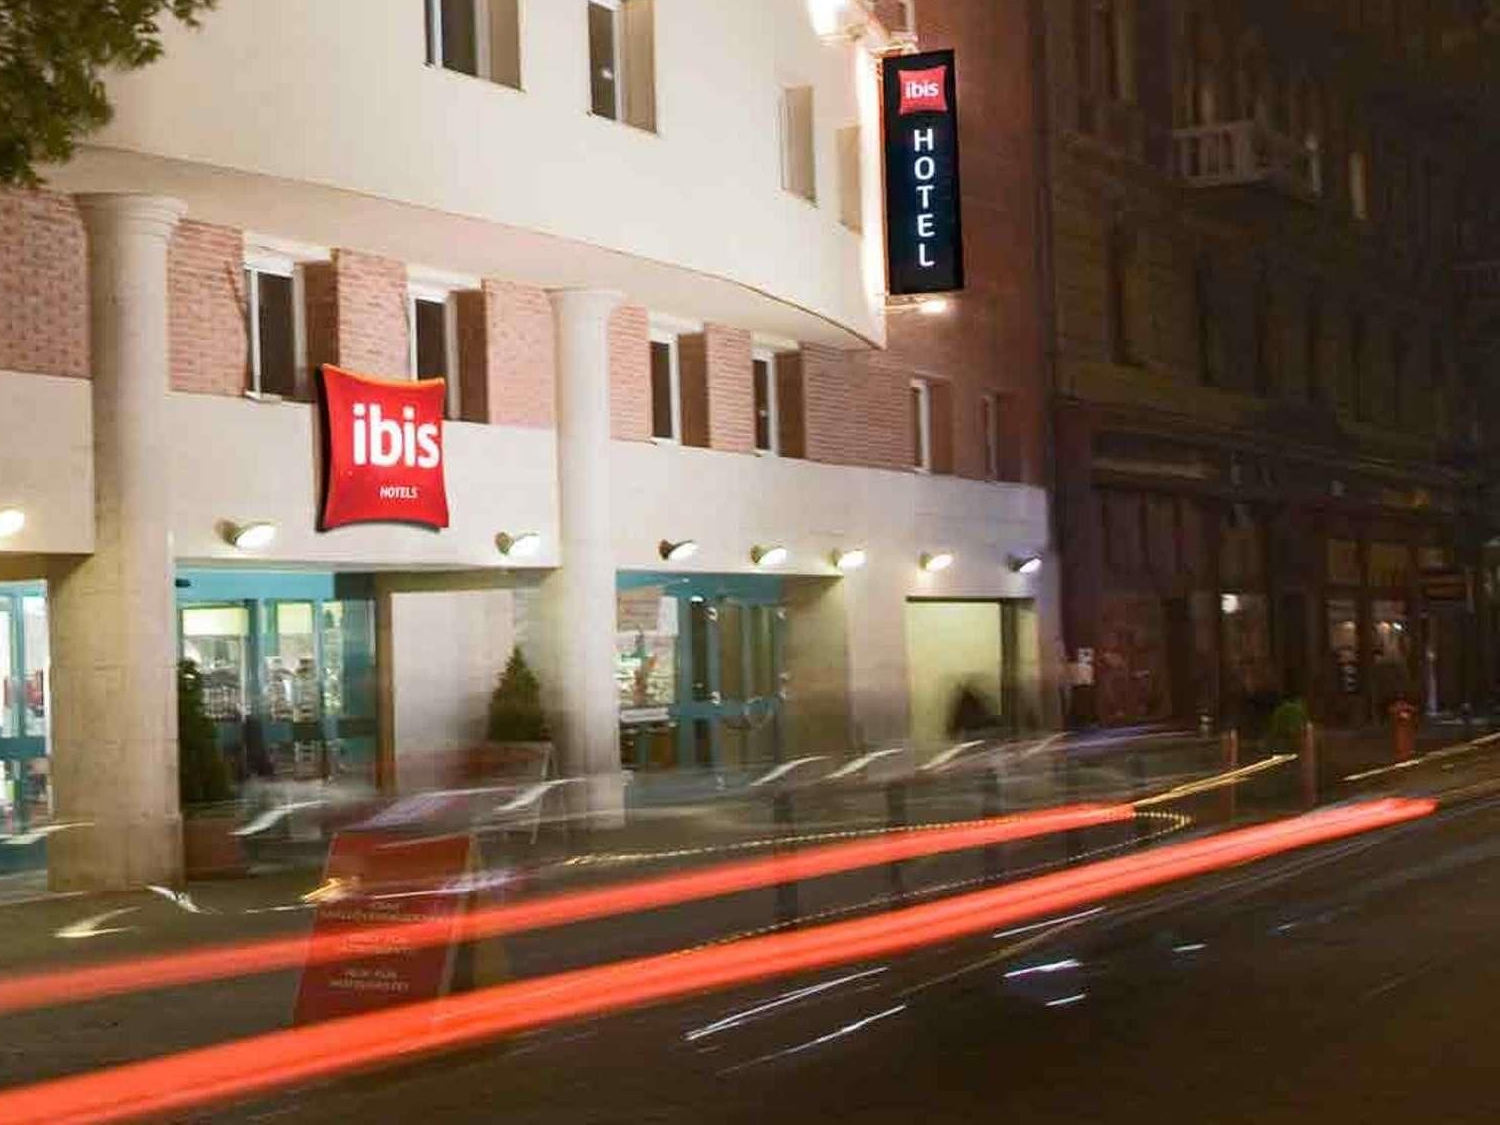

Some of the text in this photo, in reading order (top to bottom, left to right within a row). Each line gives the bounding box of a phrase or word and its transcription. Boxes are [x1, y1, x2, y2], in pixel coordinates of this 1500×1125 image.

[904, 80, 940, 100] ibis
[913, 128, 936, 267] HOTEL
[353, 402, 440, 469] ibis
[379, 485, 419, 499] HOTELS
